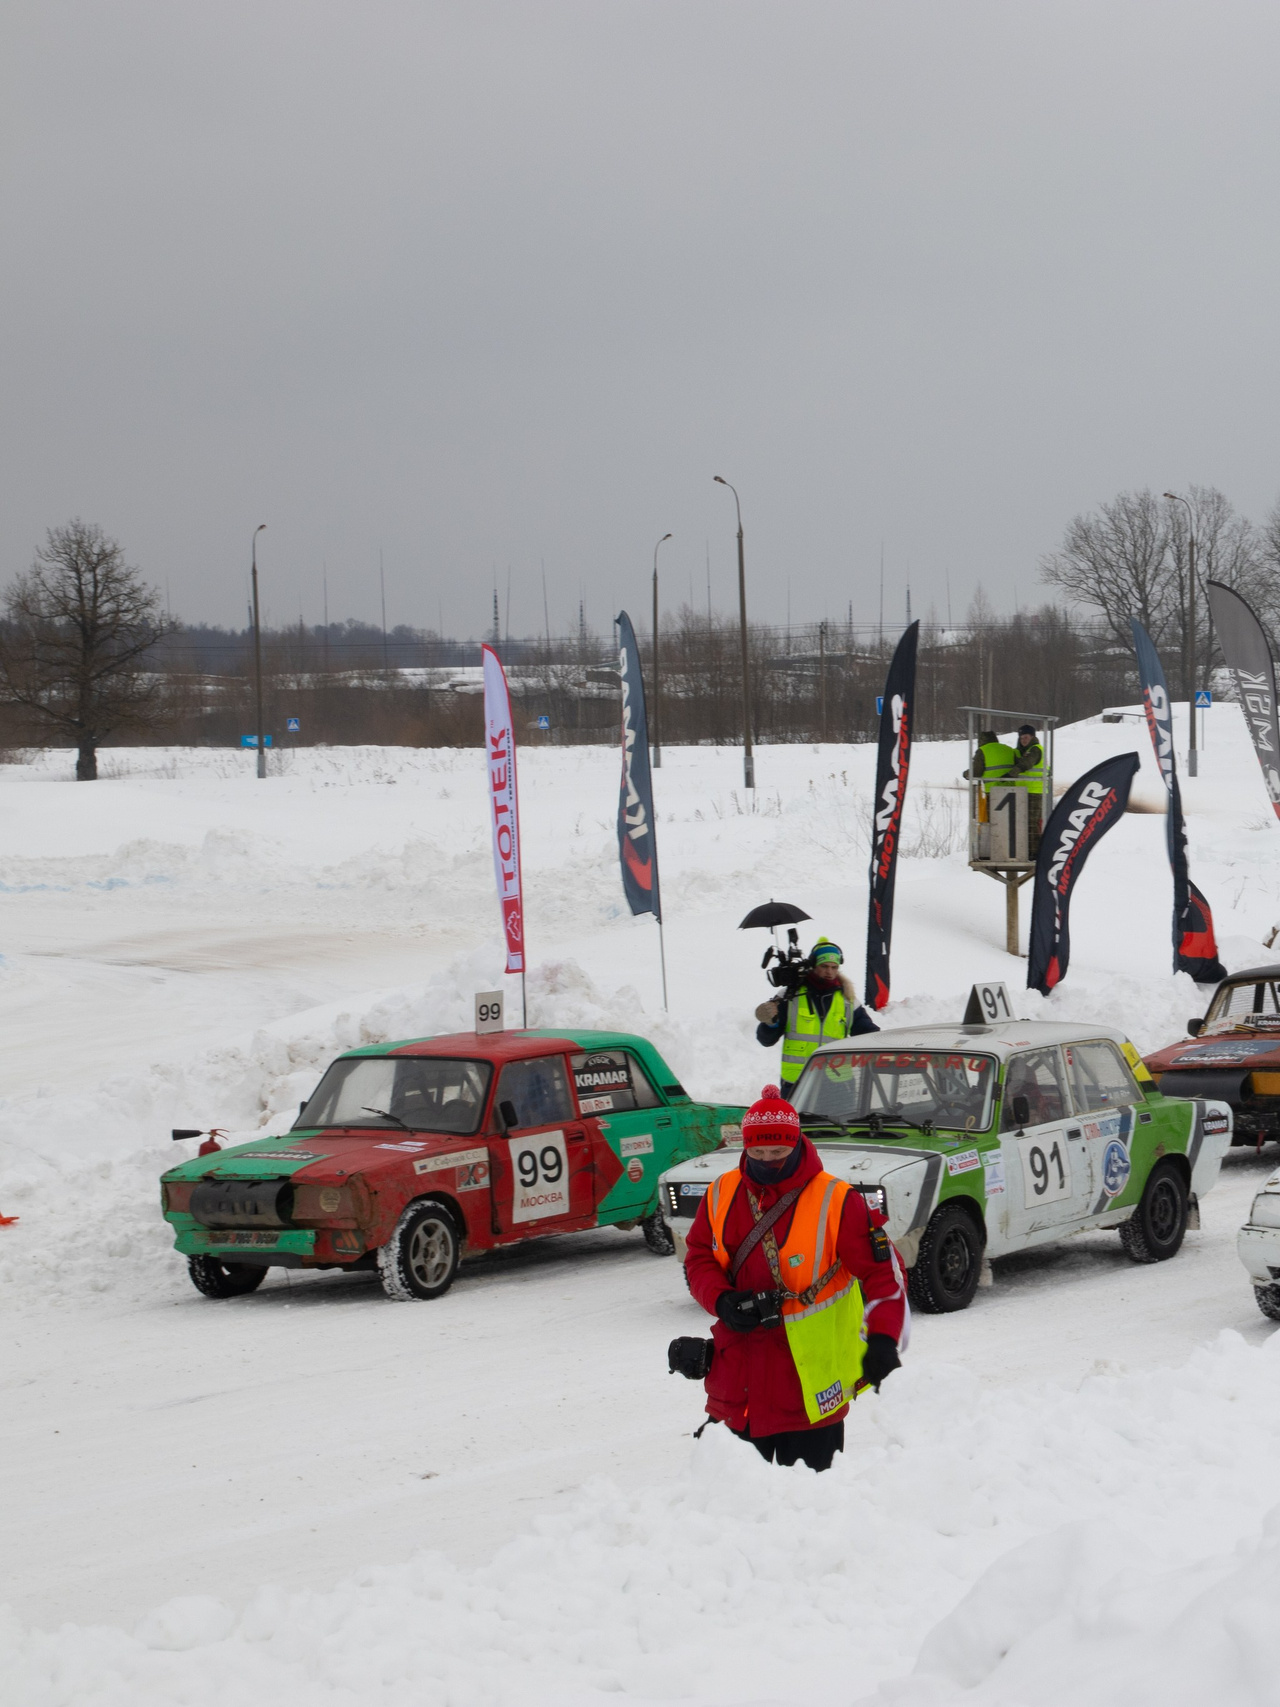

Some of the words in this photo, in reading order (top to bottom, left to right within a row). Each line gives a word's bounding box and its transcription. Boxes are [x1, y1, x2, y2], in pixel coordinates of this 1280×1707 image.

[490, 728, 514, 891] TOTEK
[995, 793, 1016, 858] 1
[1057, 788, 1118, 895] MOTORSPORT
[479, 1003, 500, 1021] 99
[982, 986, 1010, 1019] 91
[575, 1070, 628, 1087] KRAMAR
[1204, 1119, 1228, 1131] KRAMAR
[757, 1132, 782, 1142] PRO
[518, 1146, 563, 1187] 99
[1030, 1141, 1065, 1195] 91
[521, 1192, 563, 1208] МОСКВА
[818, 1381, 842, 1404] LIQUI
[819, 1392, 844, 1415] MOLY
